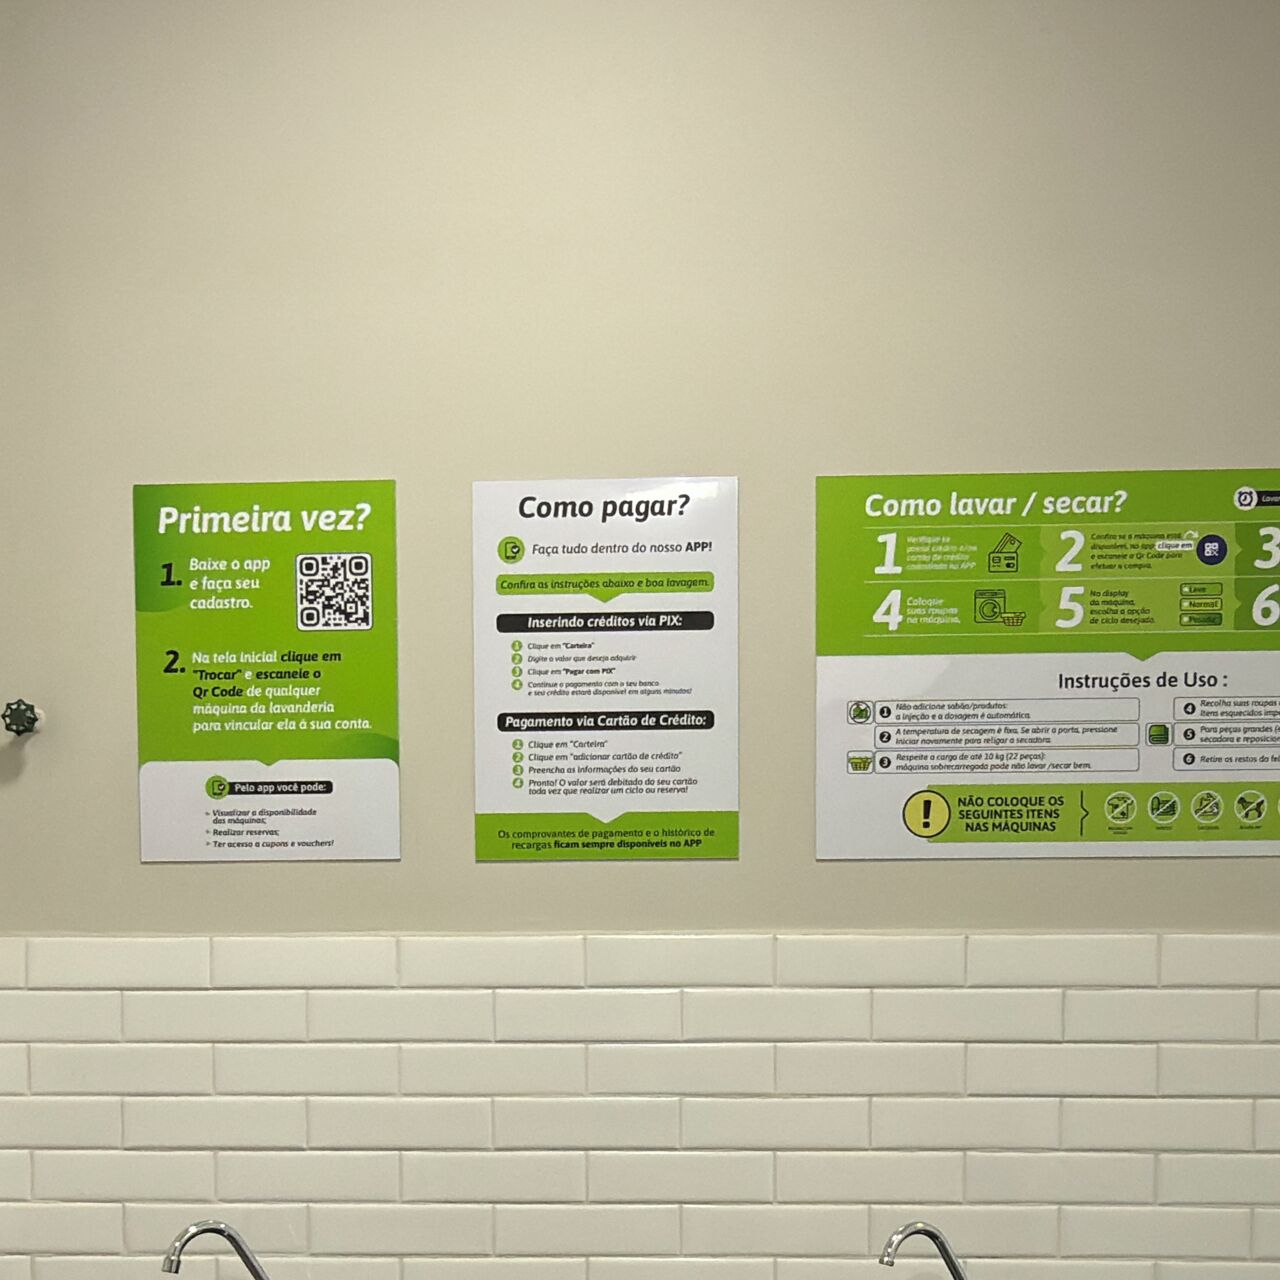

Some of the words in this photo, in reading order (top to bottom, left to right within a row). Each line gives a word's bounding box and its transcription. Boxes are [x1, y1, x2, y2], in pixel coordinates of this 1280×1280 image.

[519, 496, 593, 518] Como
[601, 494, 690, 523] pagar?
[865, 494, 941, 517] Como
[950, 491, 1017, 515] lavar
[1021, 491, 1037, 517] /
[1042, 490, 1127, 514] secar?
[158, 504, 292, 534] Primeira
[301, 502, 371, 531] vez?
[532, 544, 559, 556] Faça
[562, 543, 588, 554] tudo
[590, 542, 629, 553] dentro
[631, 542, 646, 553] do
[650, 544, 682, 552] nosso
[685, 541, 712, 552] APP!
[874, 532, 902, 574] 1
[1055, 530, 1084, 572] 2
[1157, 542, 1180, 551] clique
[189, 557, 227, 570] Baixe
[231, 559, 240, 570] o
[243, 559, 270, 573] app
[160, 562, 182, 586] 1.
[189, 580, 198, 590] e
[201, 576, 232, 593] faça
[235, 578, 260, 589] seu
[500, 580, 535, 589] Confira
[537, 581, 548, 589] as
[551, 579, 600, 590] instruções
[602, 578, 635, 588] abaixo
[645, 578, 664, 587] boa
[190, 595, 253, 609] cadastro.
[1055, 586, 1084, 628] 5
[1252, 584, 1280, 626] 6
[872, 589, 903, 631] 4
[528, 616, 584, 628] Inserindo
[587, 615, 635, 627] créditos
[638, 615, 656, 626] via
[659, 614, 682, 626] PIX:
[163, 650, 185, 673] 2.
[192, 652, 210, 663] Na
[213, 651, 236, 663] tela
[240, 650, 277, 663] inicial
[281, 650, 318, 664] clique
[322, 653, 341, 661] em
[244, 671, 252, 679] e
[256, 668, 309, 679] escaneie
[313, 670, 321, 678] o
[1059, 673, 1150, 692] Instruções
[1156, 671, 1178, 687] de
[1184, 672, 1218, 687] Uso
[193, 686, 208, 699] Qr
[211, 685, 243, 697] Code
[246, 685, 262, 697] de
[265, 684, 321, 699] qualquer
[193, 703, 247, 717] máquina
[250, 702, 266, 713] da
[269, 701, 334, 713] lavanderia
[192, 722, 221, 734] para
[224, 718, 274, 731] vincular
[276, 718, 296, 730] ela
[309, 720, 331, 730] sua
[335, 718, 372, 729] conta.
[505, 716, 573, 729] Pagamento
[576, 715, 594, 726] via
[597, 715, 638, 726] Cartão
[641, 714, 656, 726] de
[659, 713, 706, 725] Crédito:
[528, 740, 554, 749] Clique
[528, 753, 554, 762] Clique
[639, 752, 649, 760] de
[528, 766, 565, 774] Preencha
[577, 765, 626, 775] informações
[627, 765, 638, 773] do
[234, 783, 255, 792] Pelo
[257, 784, 275, 793] app
[277, 783, 298, 792] você
[300, 783, 326, 792] pode:
[958, 795, 984, 807] NÃO
[987, 796, 1045, 808] COLOQUE
[1048, 796, 1064, 806] OS
[212, 809, 250, 818] Visualizar
[258, 808, 317, 817] disponibilidade
[958, 809, 1023, 821] SEGUINTES
[1026, 808, 1060, 819] ITENS
[213, 828, 244, 836] Realizar
[498, 830, 510, 839] Os
[512, 830, 576, 840] comprovantes
[578, 829, 589, 838] de
[592, 829, 643, 840] pagamento
[661, 828, 701, 840] histórico
[703, 828, 715, 836] de
[965, 822, 989, 832] NAS
[992, 820, 1056, 833] MÁQUINAS
[512, 842, 552, 851] recargas
[554, 840, 579, 848] ficam
[581, 842, 615, 850] sempre
[683, 839, 702, 847] APP
